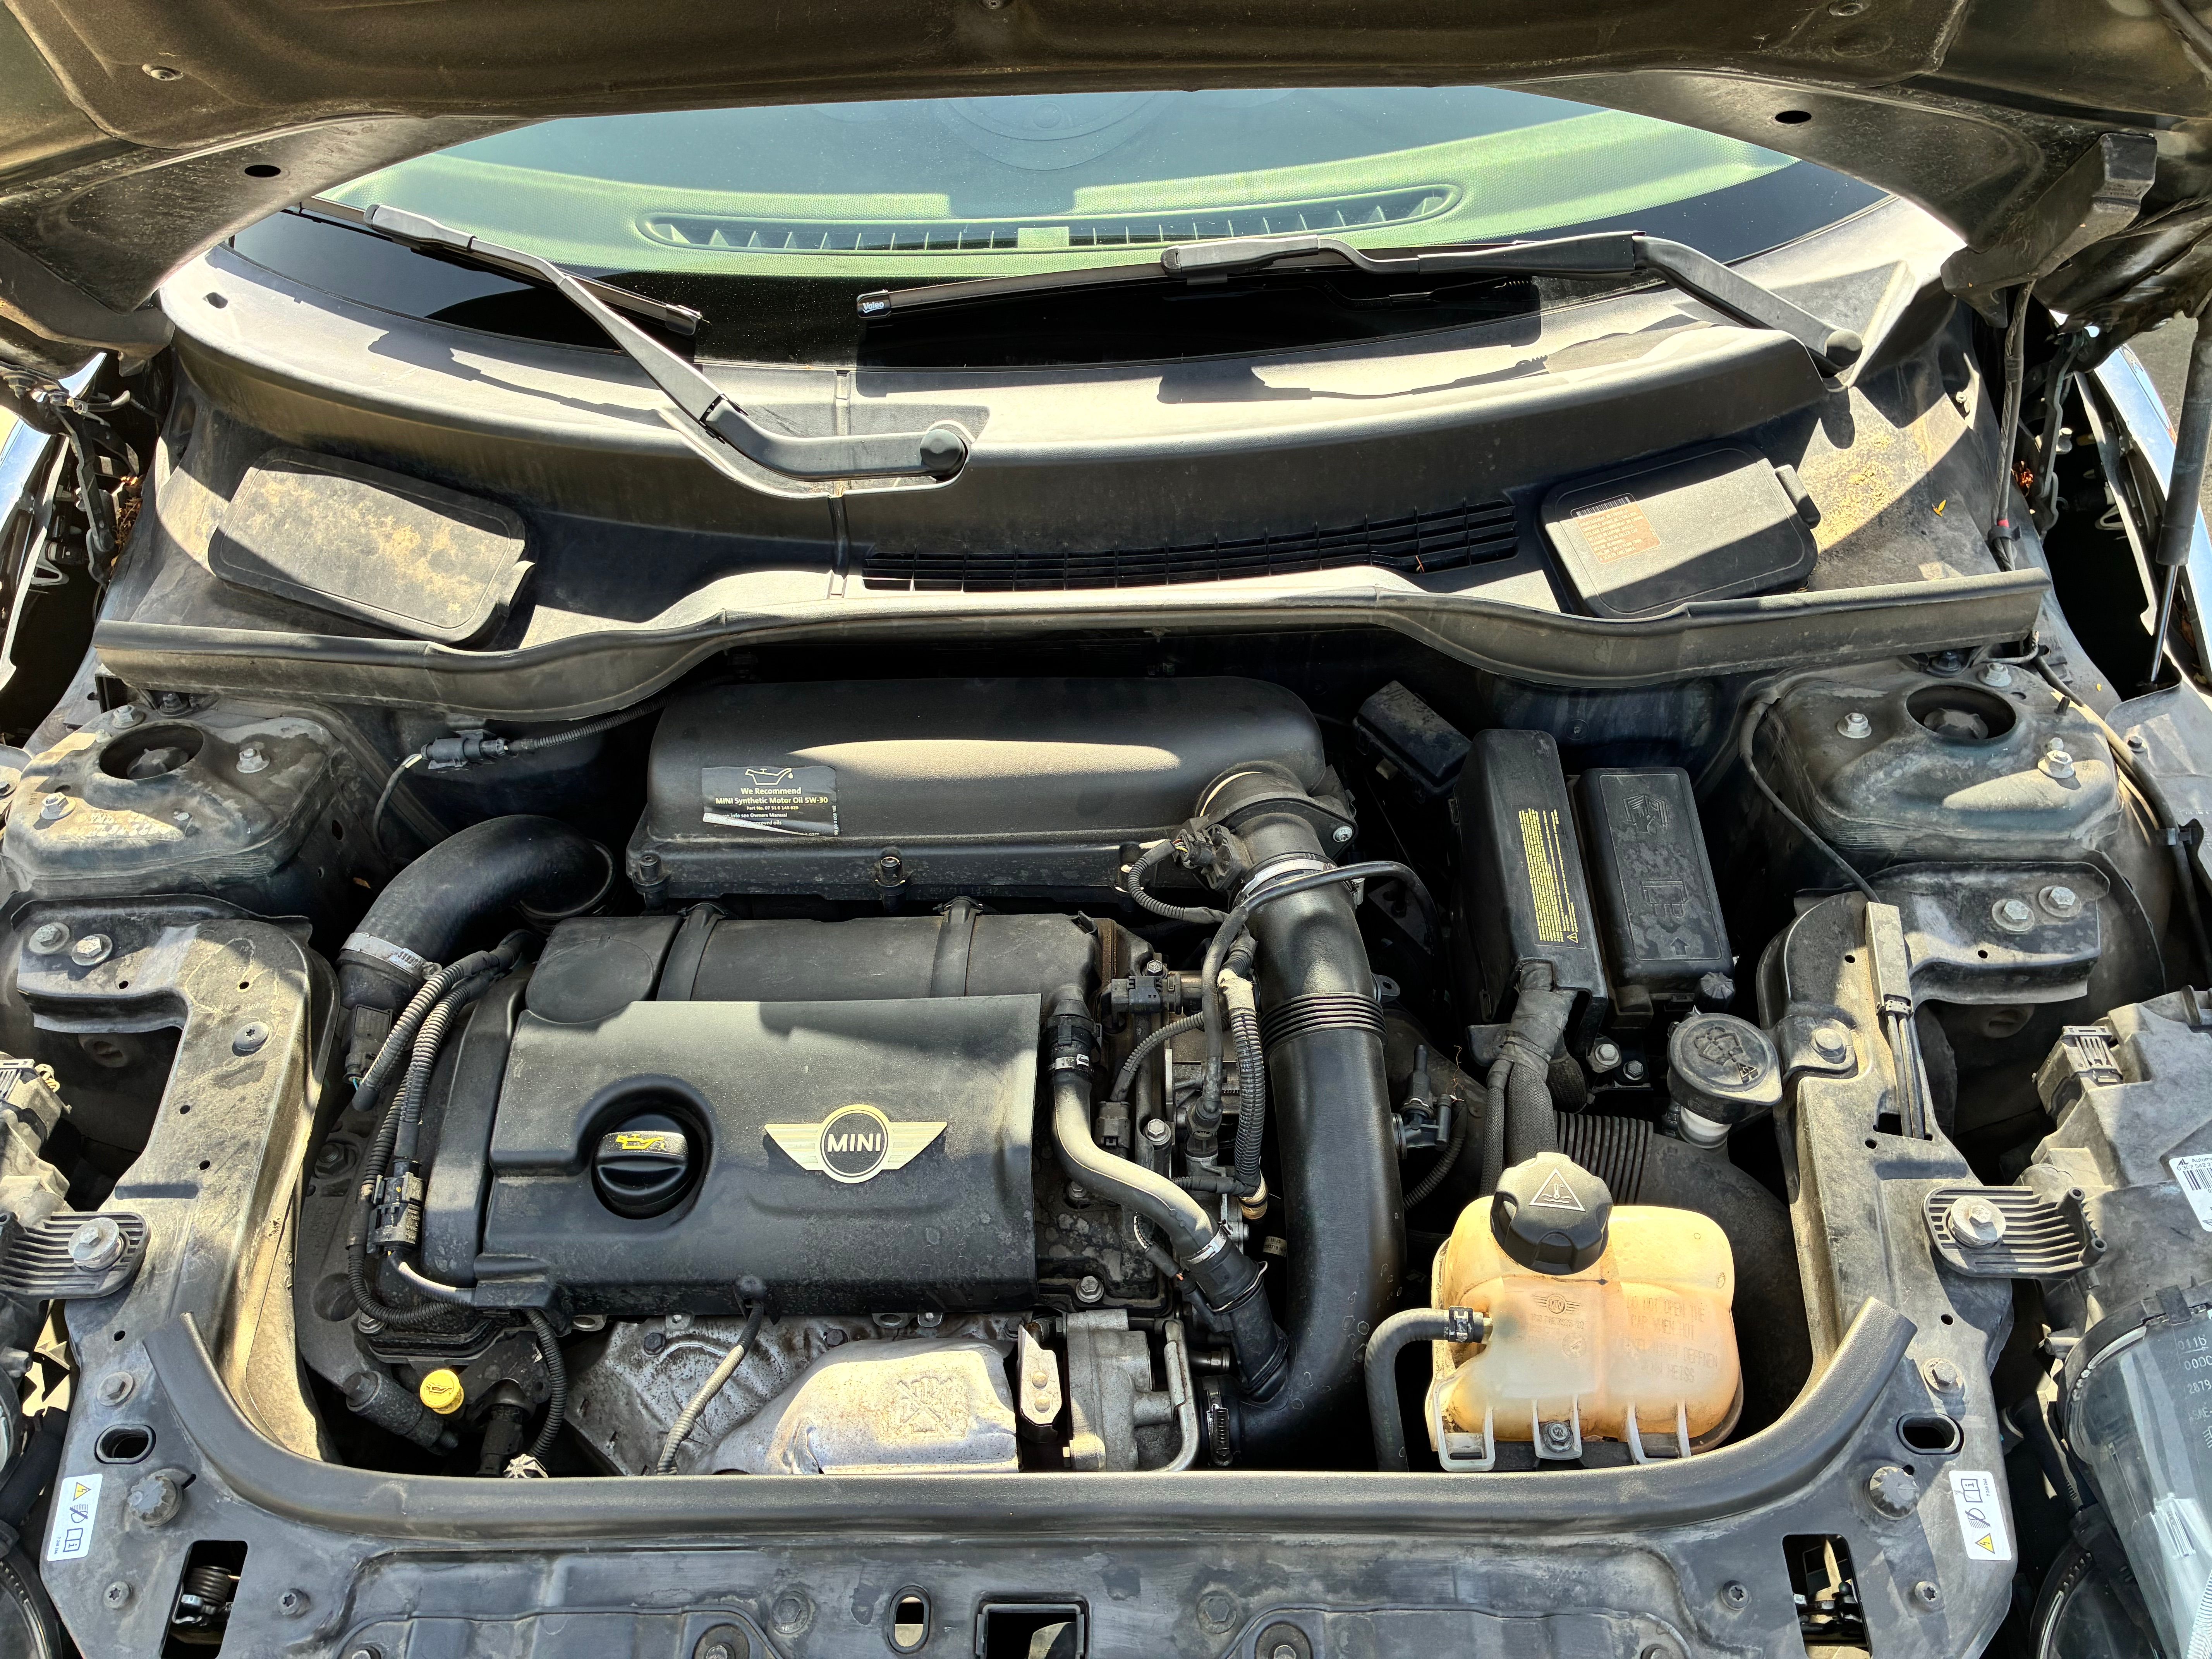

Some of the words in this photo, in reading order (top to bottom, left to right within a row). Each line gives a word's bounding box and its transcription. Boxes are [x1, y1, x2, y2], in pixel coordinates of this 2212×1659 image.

[862, 301, 884, 310] Valeo
[755, 787, 802, 795] Recommend
[734, 797, 768, 806] Synthetic
[828, 1133, 881, 1152] MINI
[1664, 1299, 1685, 1317] OPEN
[1690, 1305, 1705, 1323] THE
[1667, 1362, 1695, 1383] HEISS
